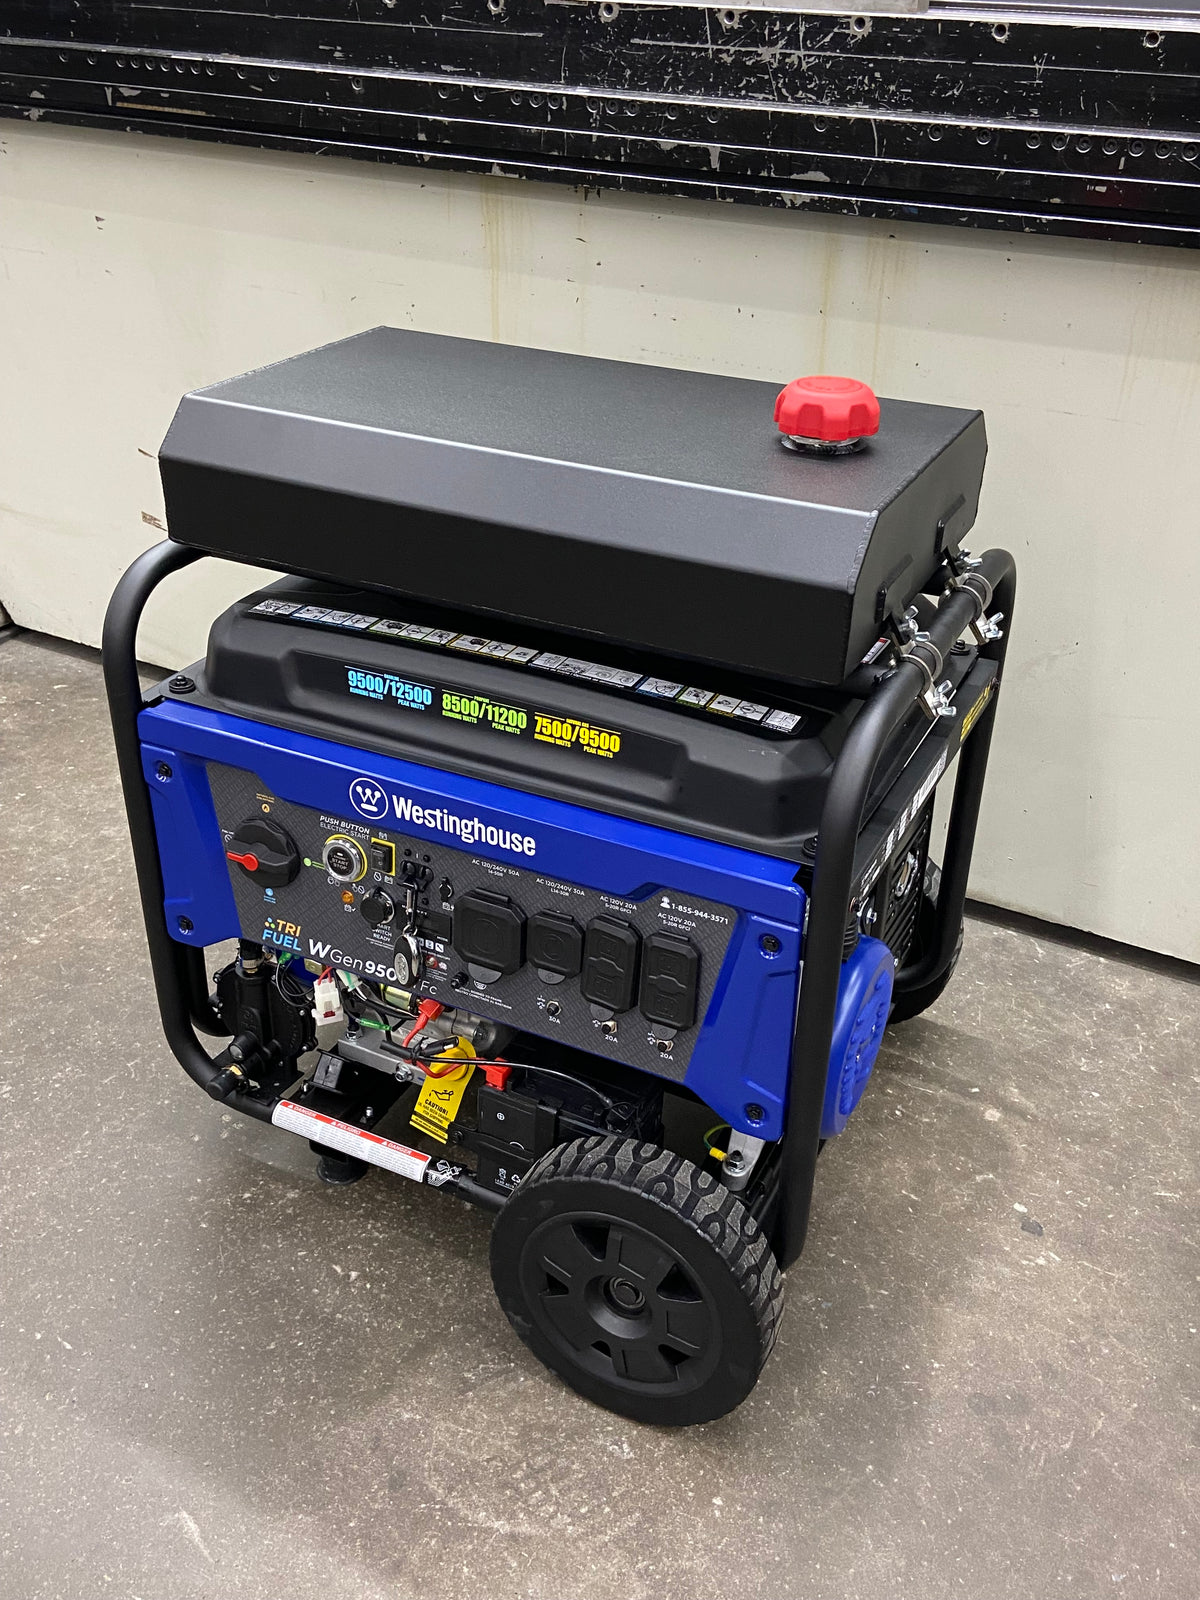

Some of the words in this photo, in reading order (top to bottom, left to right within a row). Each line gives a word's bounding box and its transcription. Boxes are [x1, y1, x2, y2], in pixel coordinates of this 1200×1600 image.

[347, 670, 432, 705] 9500/12500
[442, 693, 527, 729] 8500/11200
[534, 715, 621, 753] 7500/9500
[320, 815, 340, 826] PUSH
[340, 821, 370, 834] BUTTON
[320, 822, 349, 835] ELECTRIC
[350, 830, 370, 841] START
[391, 794, 536, 856] Westinghouse
[481, 861, 507, 873] 120/240V
[545, 880, 572, 892] 120/240V
[609, 898, 624, 906] 120V
[625, 903, 637, 911] 20A
[667, 914, 683, 924] 120V
[683, 919, 696, 928] 20A
[671, 903, 729, 925] 1-855-944-3571
[276, 919, 301, 937] TRI
[262, 929, 302, 951] FUEL
[605, 1034, 618, 1043] 20A
[660, 1052, 674, 1061] 20A
[293, 1105, 317, 1118] DANGER
[424, 1098, 449, 1116] CAUTION!
[337, 1121, 361, 1136] PELIGRO
[387, 1142, 412, 1156] DANGER
